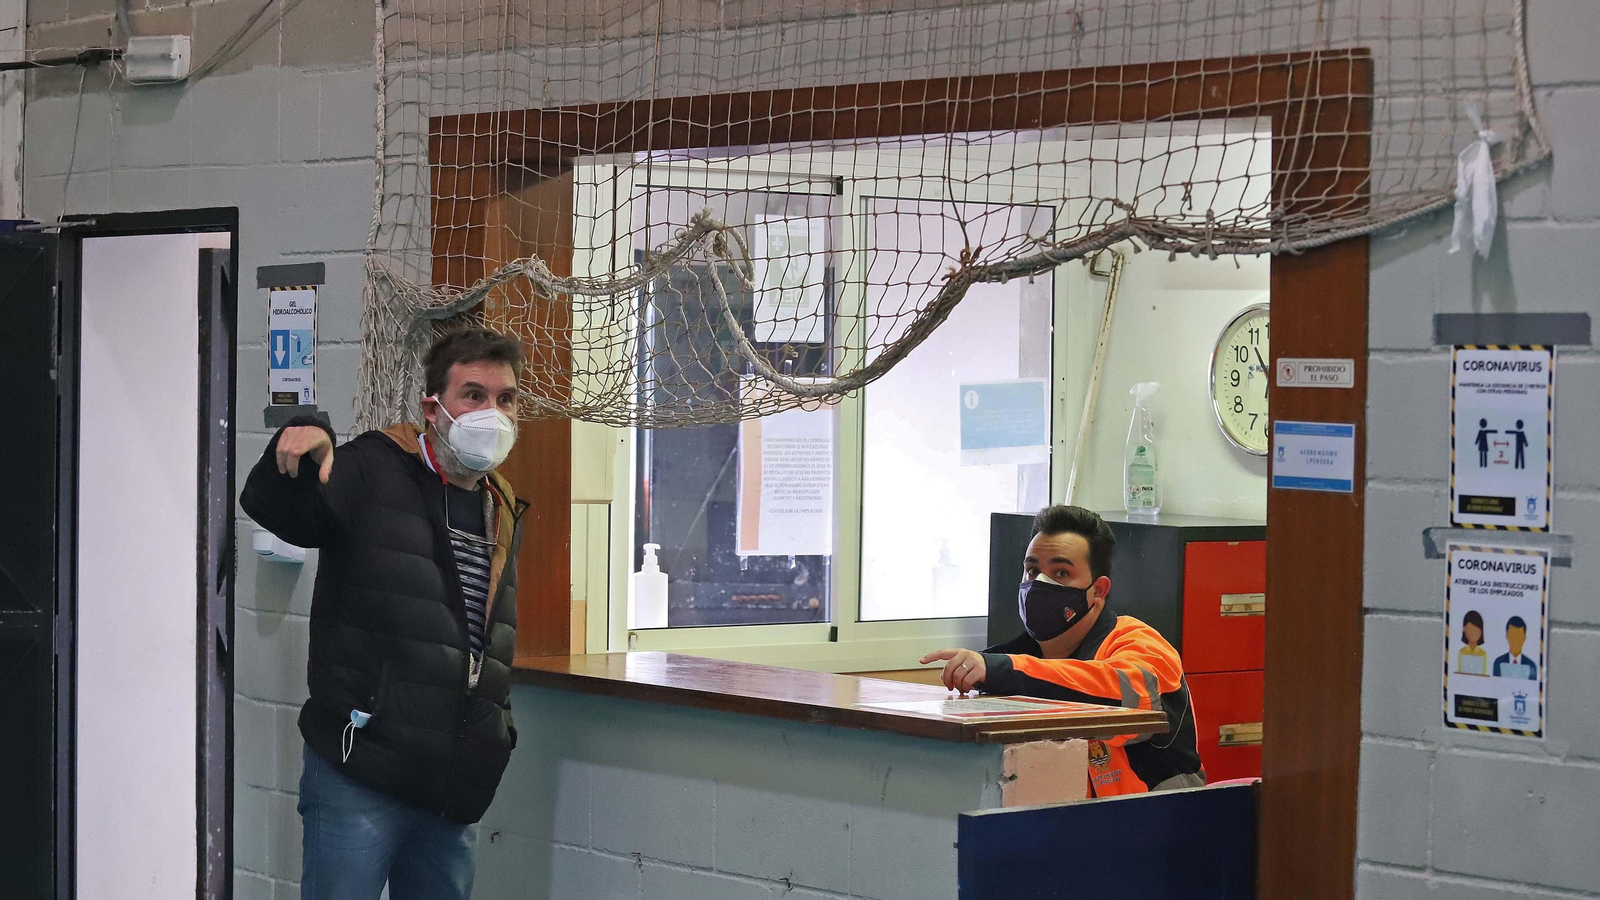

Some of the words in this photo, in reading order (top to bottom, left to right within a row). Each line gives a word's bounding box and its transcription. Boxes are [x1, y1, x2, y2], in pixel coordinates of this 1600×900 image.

[1248, 328, 1260, 345] 11
[1234, 346, 1248, 362] 10
[1463, 360, 1542, 372] CORONAVIRUS
[1230, 370, 1240, 387] 9
[1234, 396, 1244, 413] 8
[1248, 413, 1258, 430] 7
[1458, 559, 1537, 575] CORONAVIRUS
[1490, 589, 1524, 597] EMPLEADOS
[1493, 582, 1538, 591] INSTRUCCIONES
